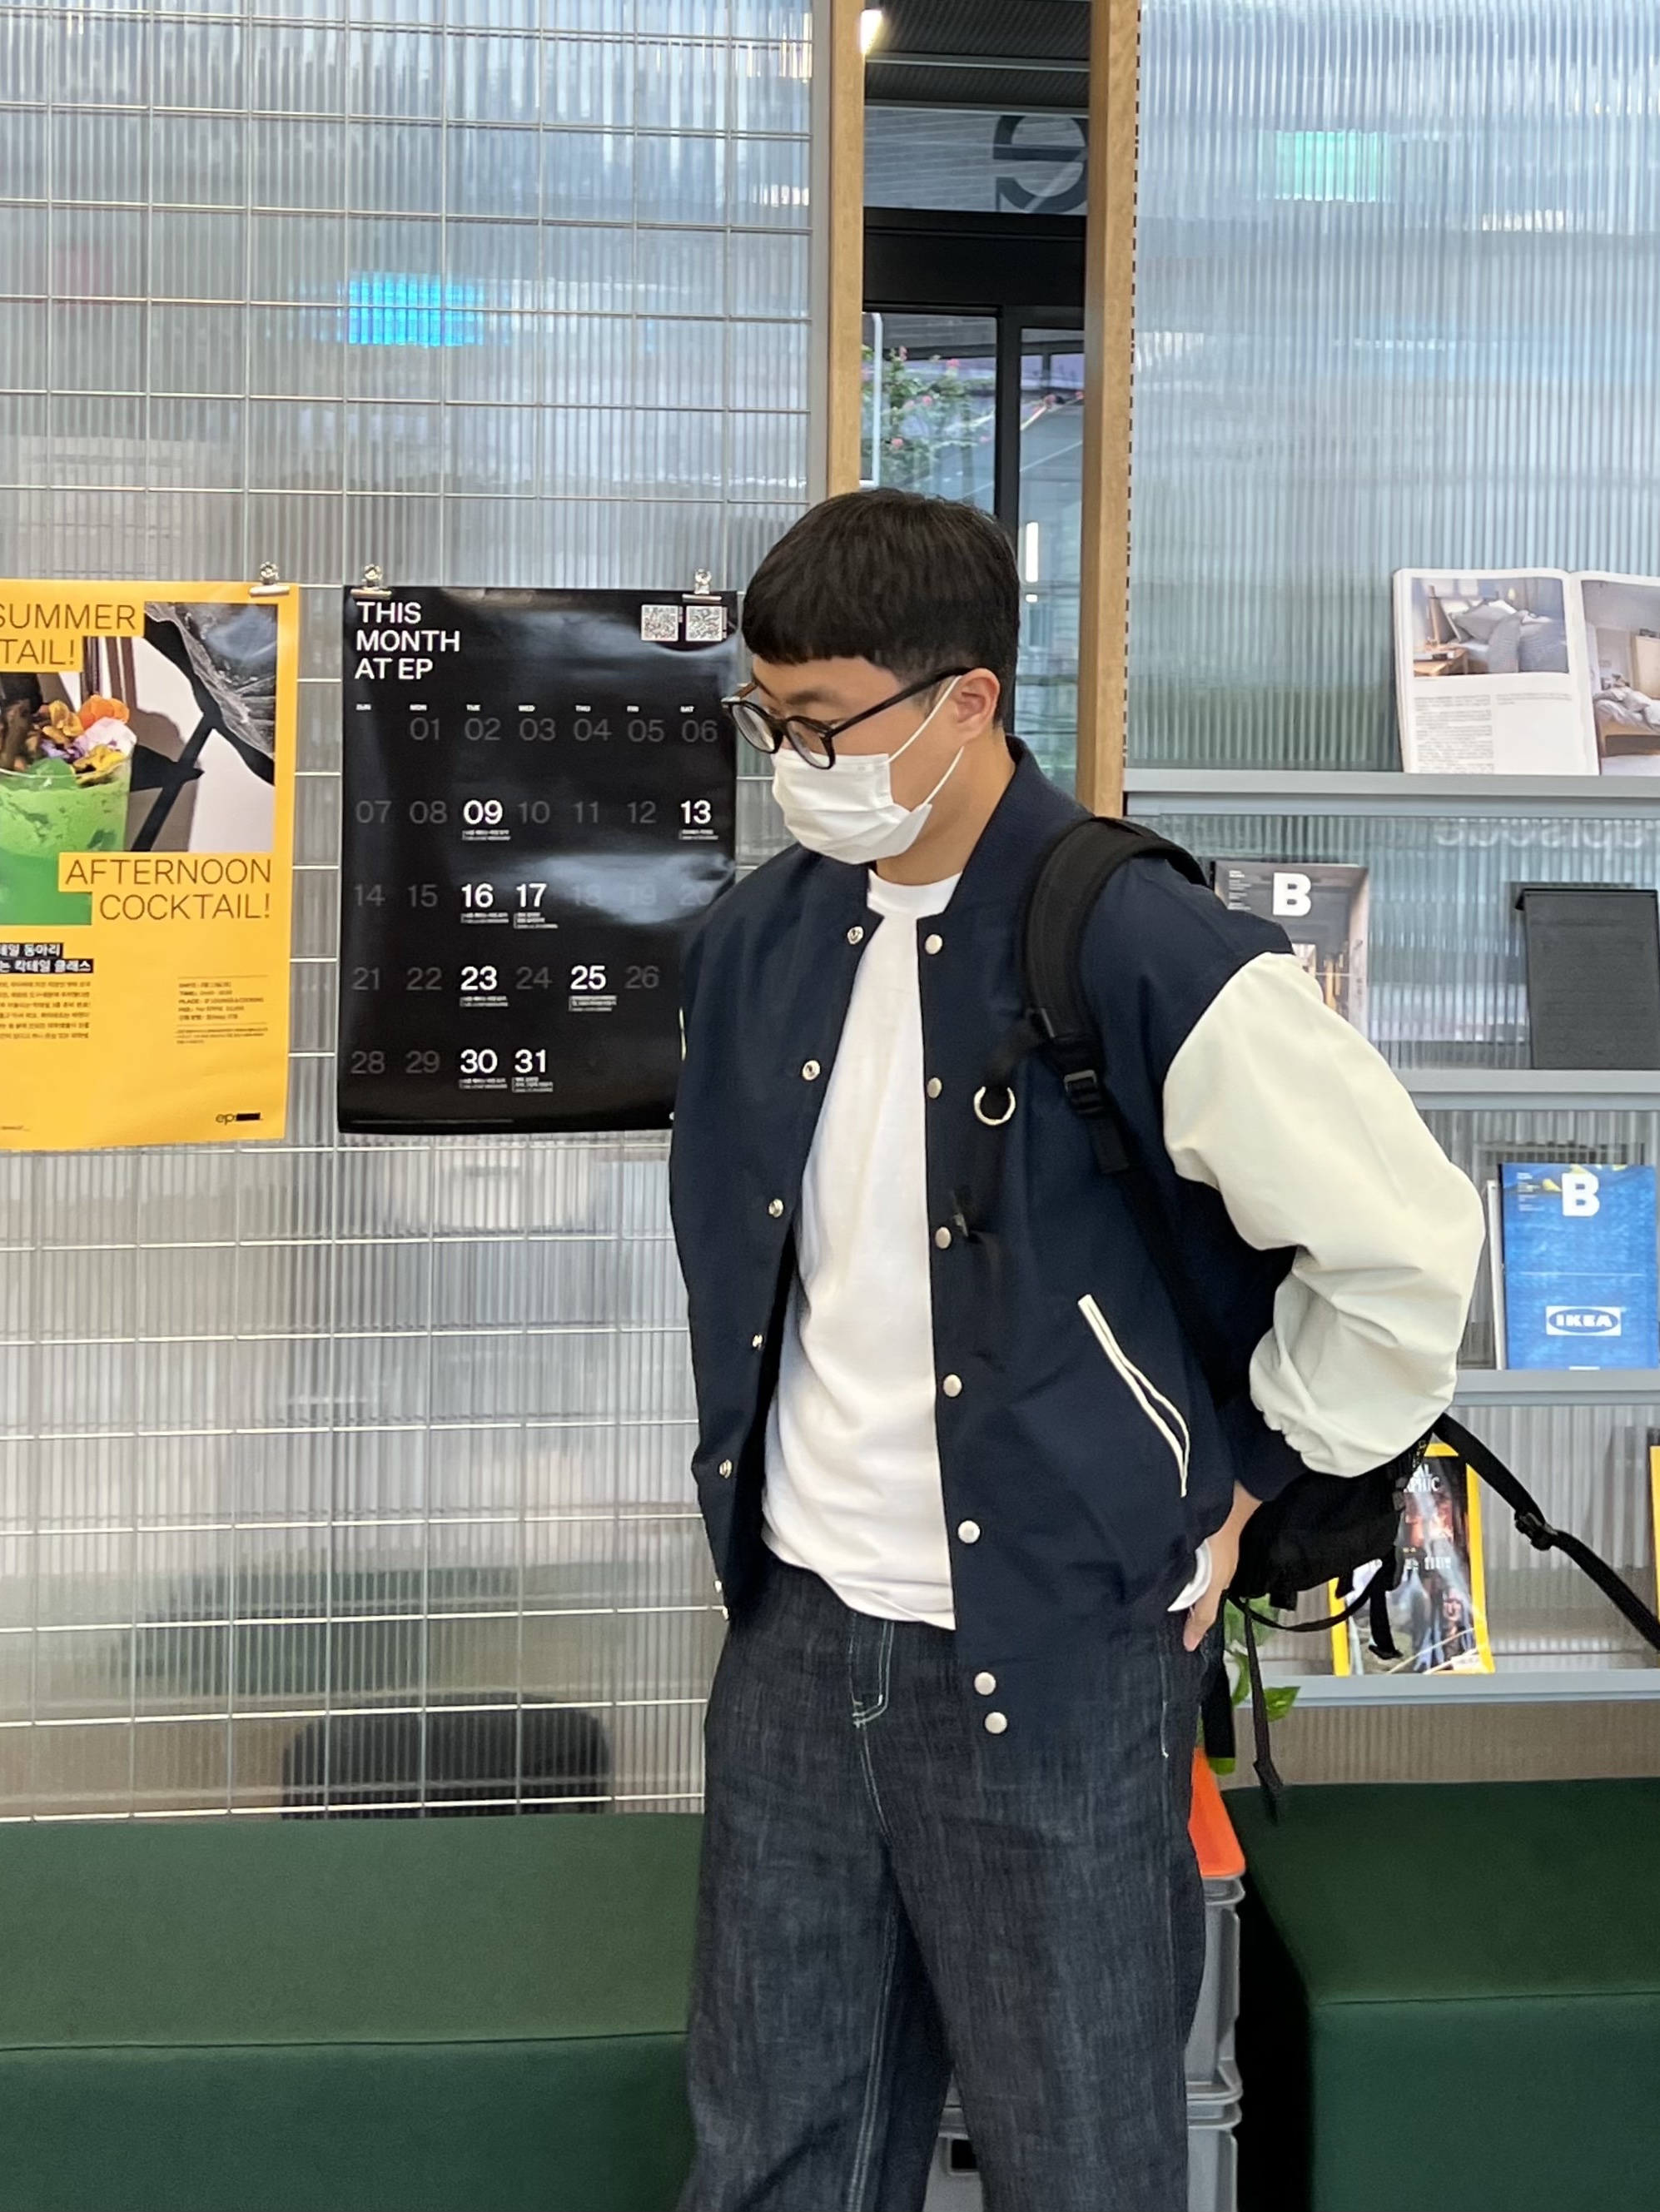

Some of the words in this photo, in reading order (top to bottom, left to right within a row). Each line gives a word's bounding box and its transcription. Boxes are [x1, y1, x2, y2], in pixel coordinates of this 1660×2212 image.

[356, 602, 420, 624] THIS
[357, 630, 460, 651] MONTH
[355, 658, 392, 679] AT
[399, 659, 432, 679] EP
[410, 718, 439, 740] 01
[465, 718, 499, 740] 02
[519, 718, 554, 740] 03
[574, 718, 611, 741] 04
[629, 719, 664, 742] 05
[682, 720, 717, 742] 06
[356, 801, 390, 823] 07
[410, 801, 447, 823] 08
[464, 800, 502, 824] 09
[519, 801, 549, 823] 10
[574, 802, 598, 823] 11
[628, 801, 655, 823] 12
[682, 800, 711, 823] 13
[65, 858, 271, 885] AFTERNOON
[355, 884, 385, 906] 14
[409, 884, 437, 907] 15
[462, 883, 493, 907] 16
[517, 883, 546, 907] 17
[679, 884, 711, 905] 20
[1273, 872, 1311, 916] B
[99, 893, 270, 920] COCKTAIL!
[351, 967, 378, 990] 21
[407, 967, 441, 990] 22
[461, 966, 497, 990] 23
[517, 967, 552, 989] 24
[571, 966, 605, 989] 25
[625, 966, 659, 988] 26
[351, 1051, 385, 1073] 28
[406, 1051, 440, 1073] 29
[461, 1050, 497, 1073] 30
[515, 1050, 545, 1073] 31
[1562, 1173, 1600, 1216] B
[1555, 1314, 1613, 1328] IKEA
